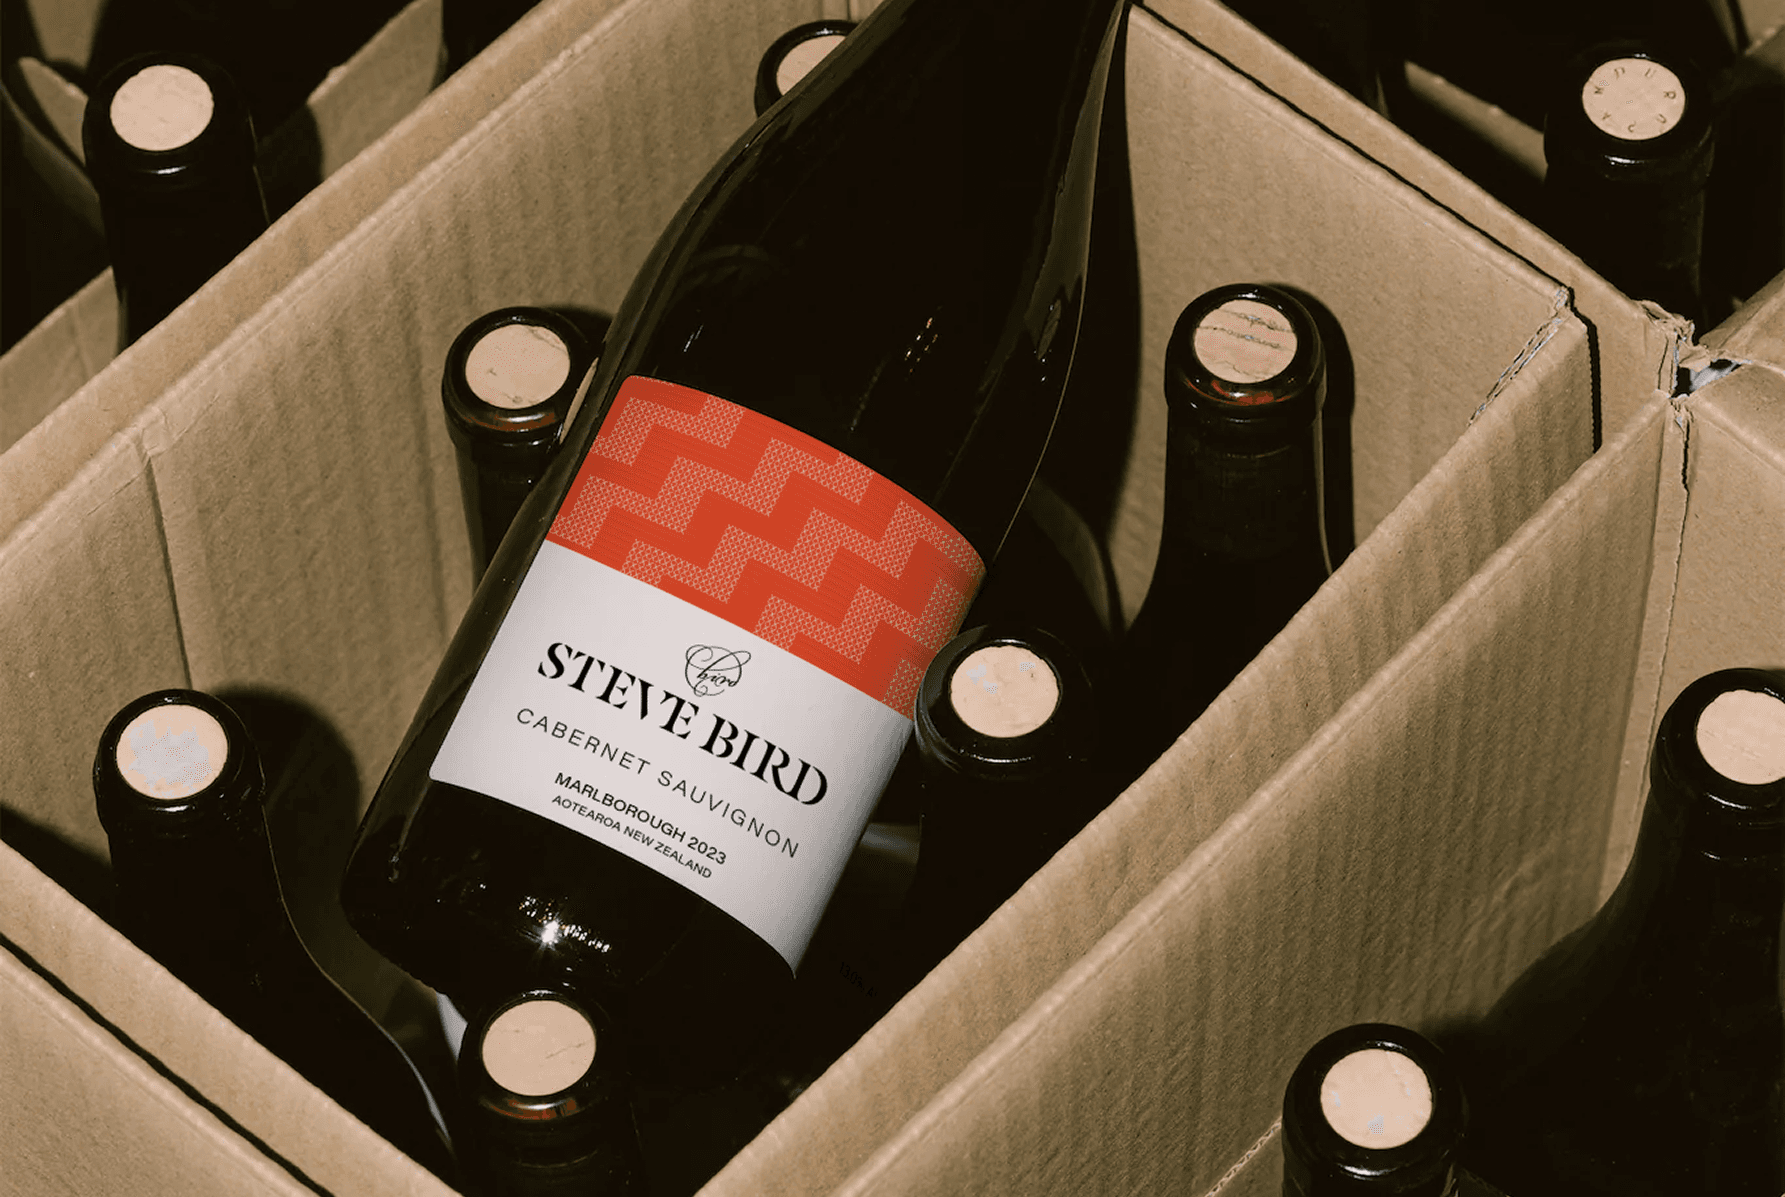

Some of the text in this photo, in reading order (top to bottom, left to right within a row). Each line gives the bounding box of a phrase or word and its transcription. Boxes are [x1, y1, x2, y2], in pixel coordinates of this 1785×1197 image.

[516, 708, 799, 858] CABERNET SAUVIGNON
[537, 642, 828, 806] STEVE BIRD
[551, 795, 712, 879] AOTEAROA NEW ZEALAND
[554, 772, 727, 865] MARLBOROUGH 2023
